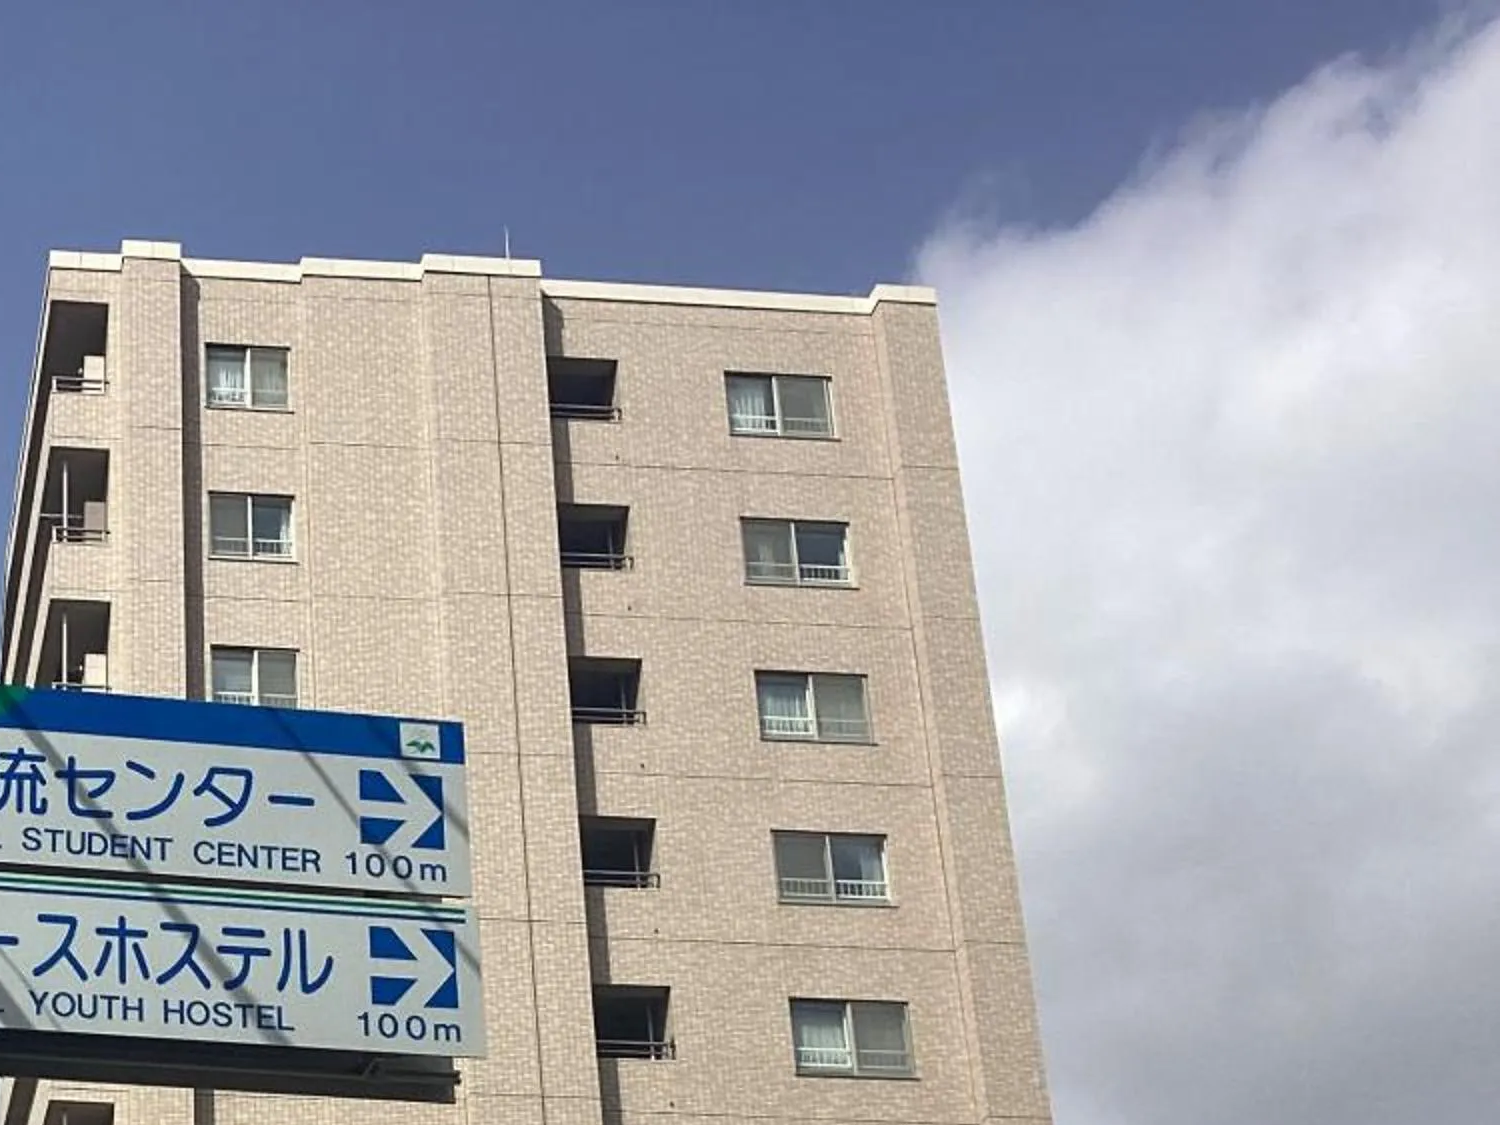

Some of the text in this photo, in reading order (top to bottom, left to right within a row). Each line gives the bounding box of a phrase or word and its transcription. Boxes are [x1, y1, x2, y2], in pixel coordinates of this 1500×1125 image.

[21, 826, 173, 863] STUDENT
[193, 840, 321, 874] CENTER
[345, 852, 447, 882] 100m
[29, 990, 145, 1022] YOUTH
[163, 999, 295, 1031] HOSTEL
[357, 1011, 462, 1043] 100m
